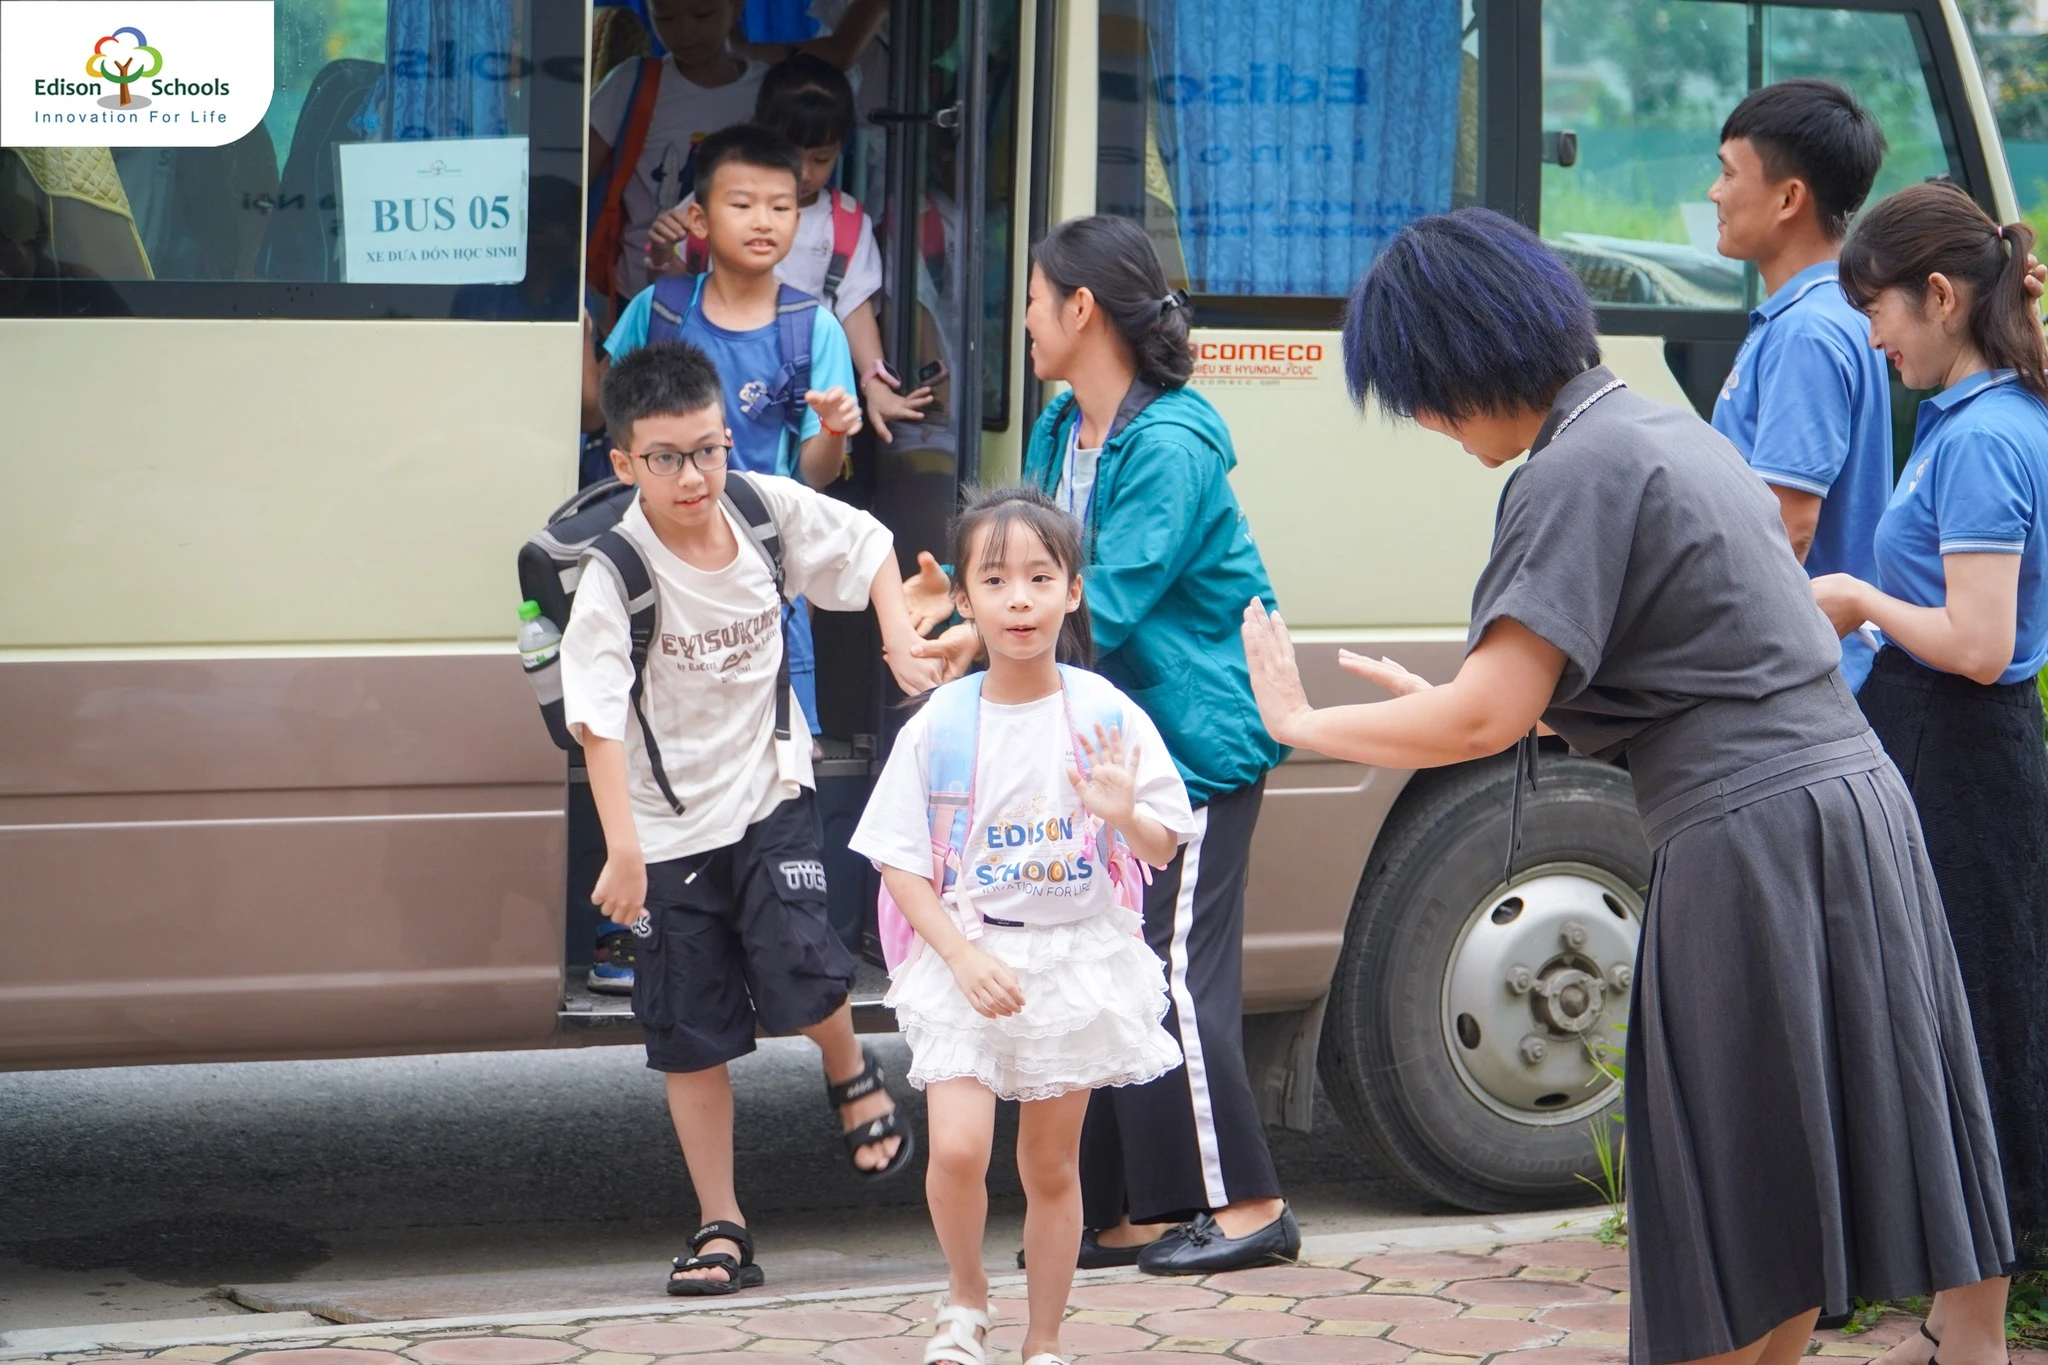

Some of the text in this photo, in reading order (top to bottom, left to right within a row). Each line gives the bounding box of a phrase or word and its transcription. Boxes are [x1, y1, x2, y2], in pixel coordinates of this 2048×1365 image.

[373, 197, 456, 232] BUS
[469, 195, 510, 230] 05
[366, 251, 385, 264] XE
[453, 248, 484, 262] HỌC
[486, 246, 517, 259] SINH
[1218, 364, 1232, 375] XE
[1235, 364, 1281, 376] HYUNDAI
[987, 816, 1074, 849] EDISON
[976, 856, 1093, 886] SCHOOLS
[1046, 886, 1072, 898] FOR
